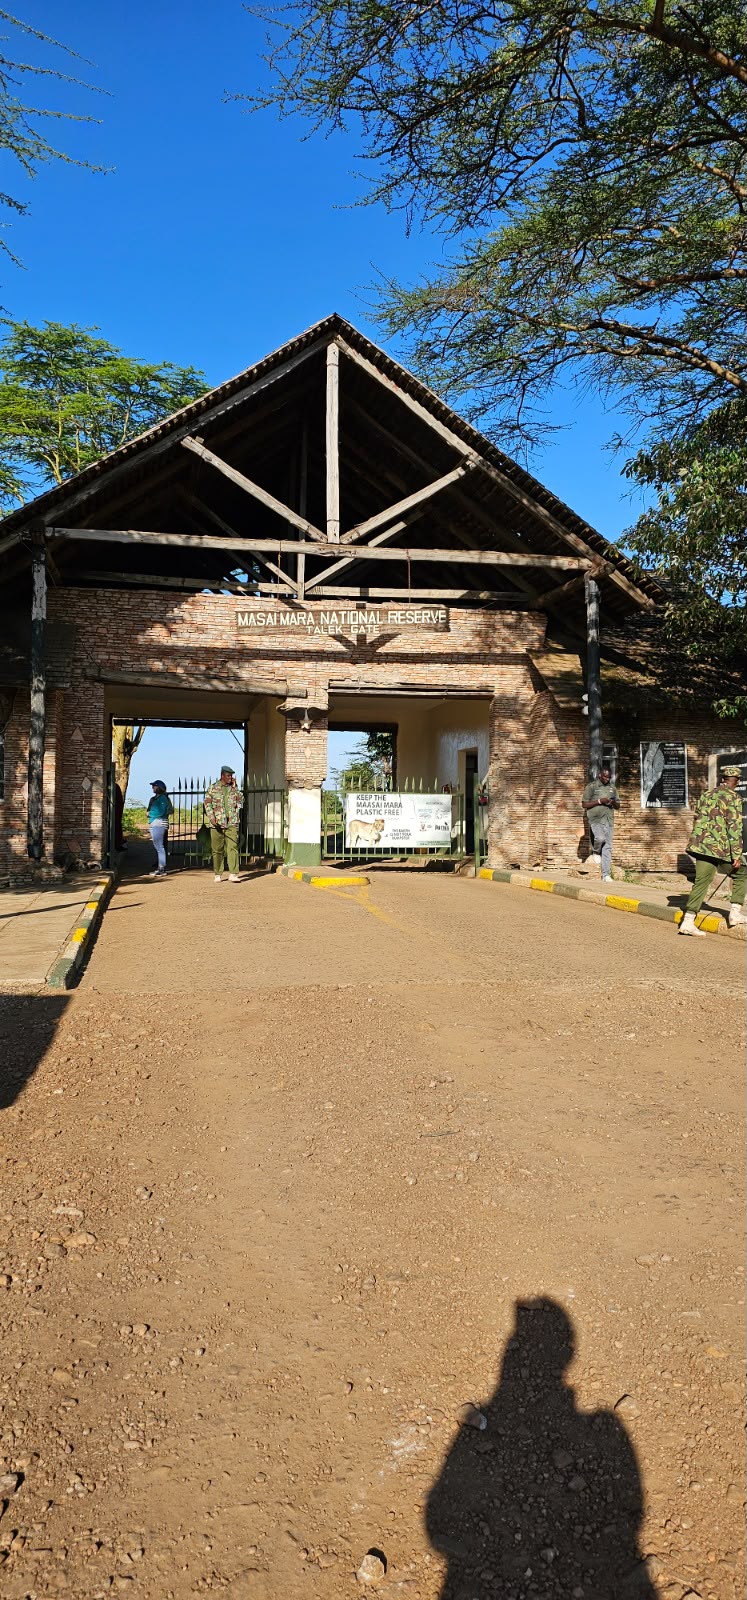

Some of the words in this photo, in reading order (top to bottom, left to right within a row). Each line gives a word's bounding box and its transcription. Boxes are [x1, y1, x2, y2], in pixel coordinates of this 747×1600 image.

[237, 612, 276, 626] MASAI
[280, 611, 315, 625] MARA
[320, 610, 383, 625] NATIONAL
[388, 609, 447, 624] RESERVE
[306, 625, 342, 634] TALEK
[350, 624, 380, 633] GATE
[356, 808, 383, 816] PLASTIC
